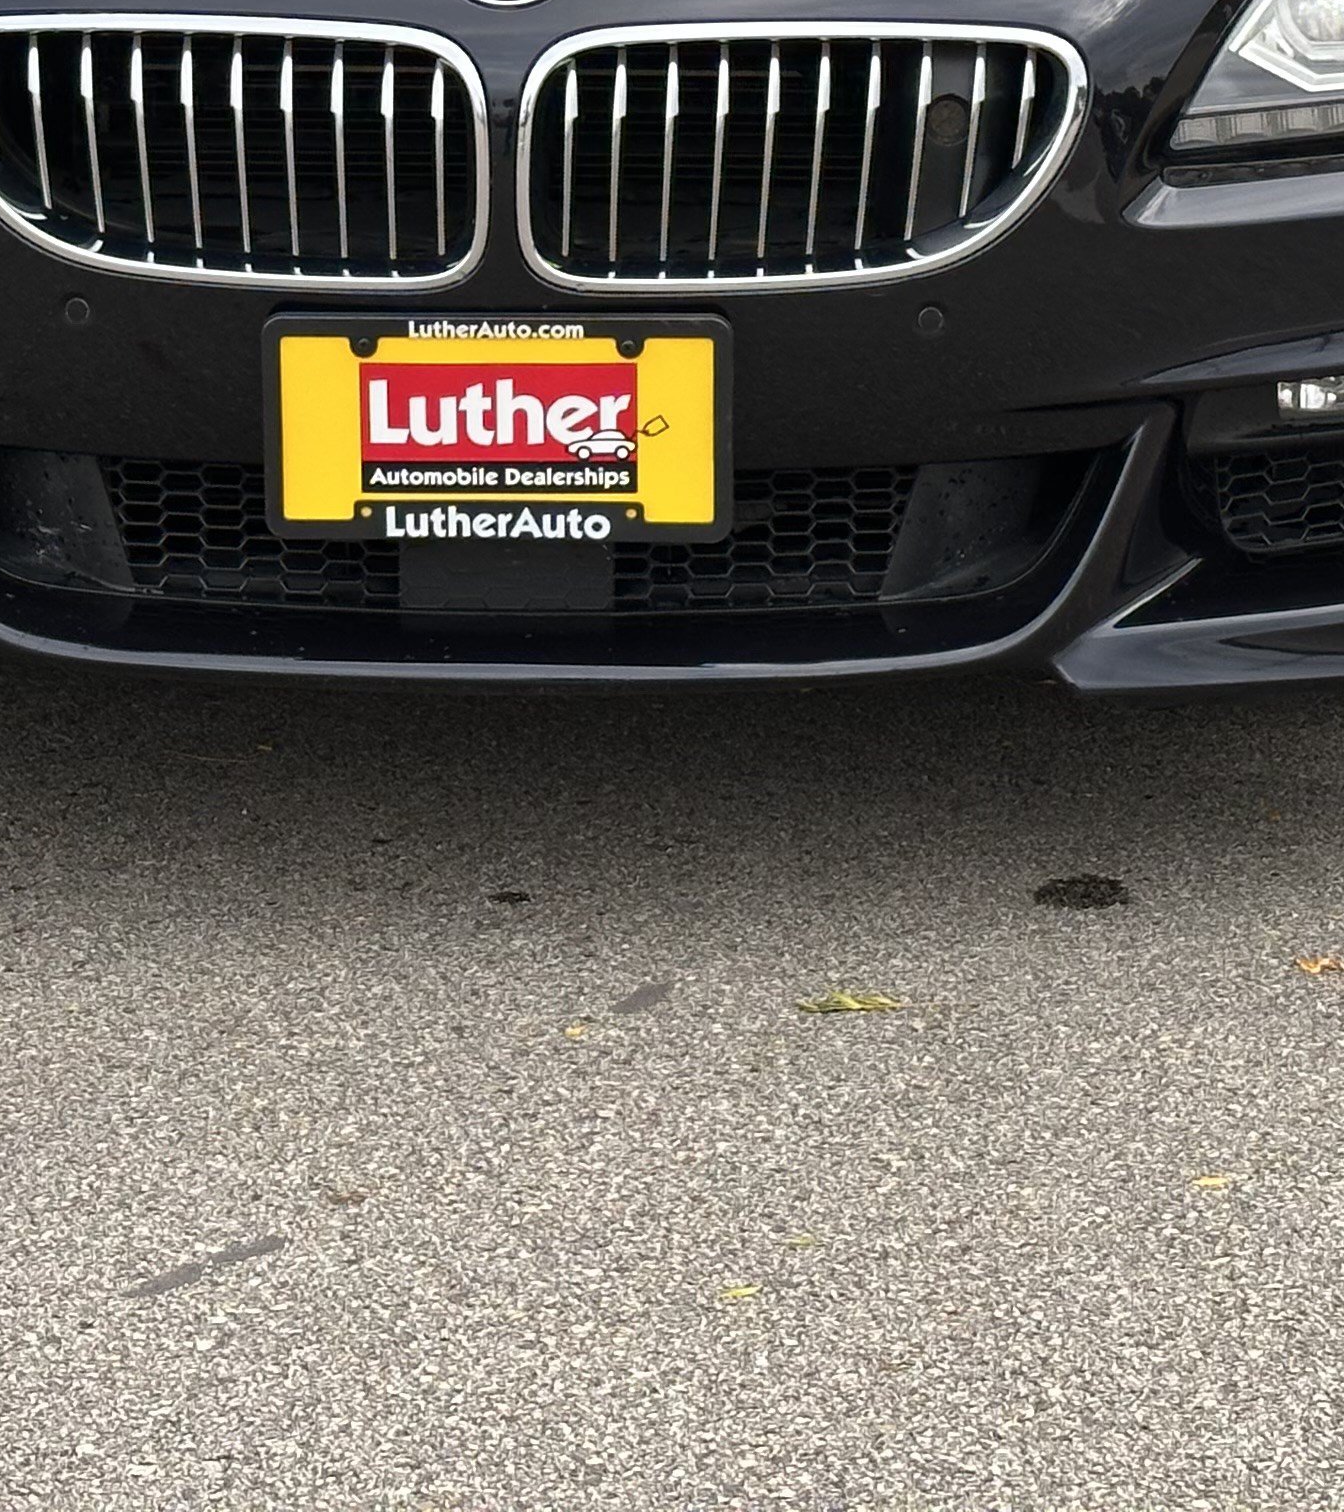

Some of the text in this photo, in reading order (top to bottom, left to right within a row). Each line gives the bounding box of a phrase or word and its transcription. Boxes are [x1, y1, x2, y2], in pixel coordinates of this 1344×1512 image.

[408, 321, 584, 339] LutherAuto.com
[368, 378, 631, 446] Luther
[369, 467, 630, 489] Automobile Dealerships
[385, 505, 611, 540] LutherAuto
